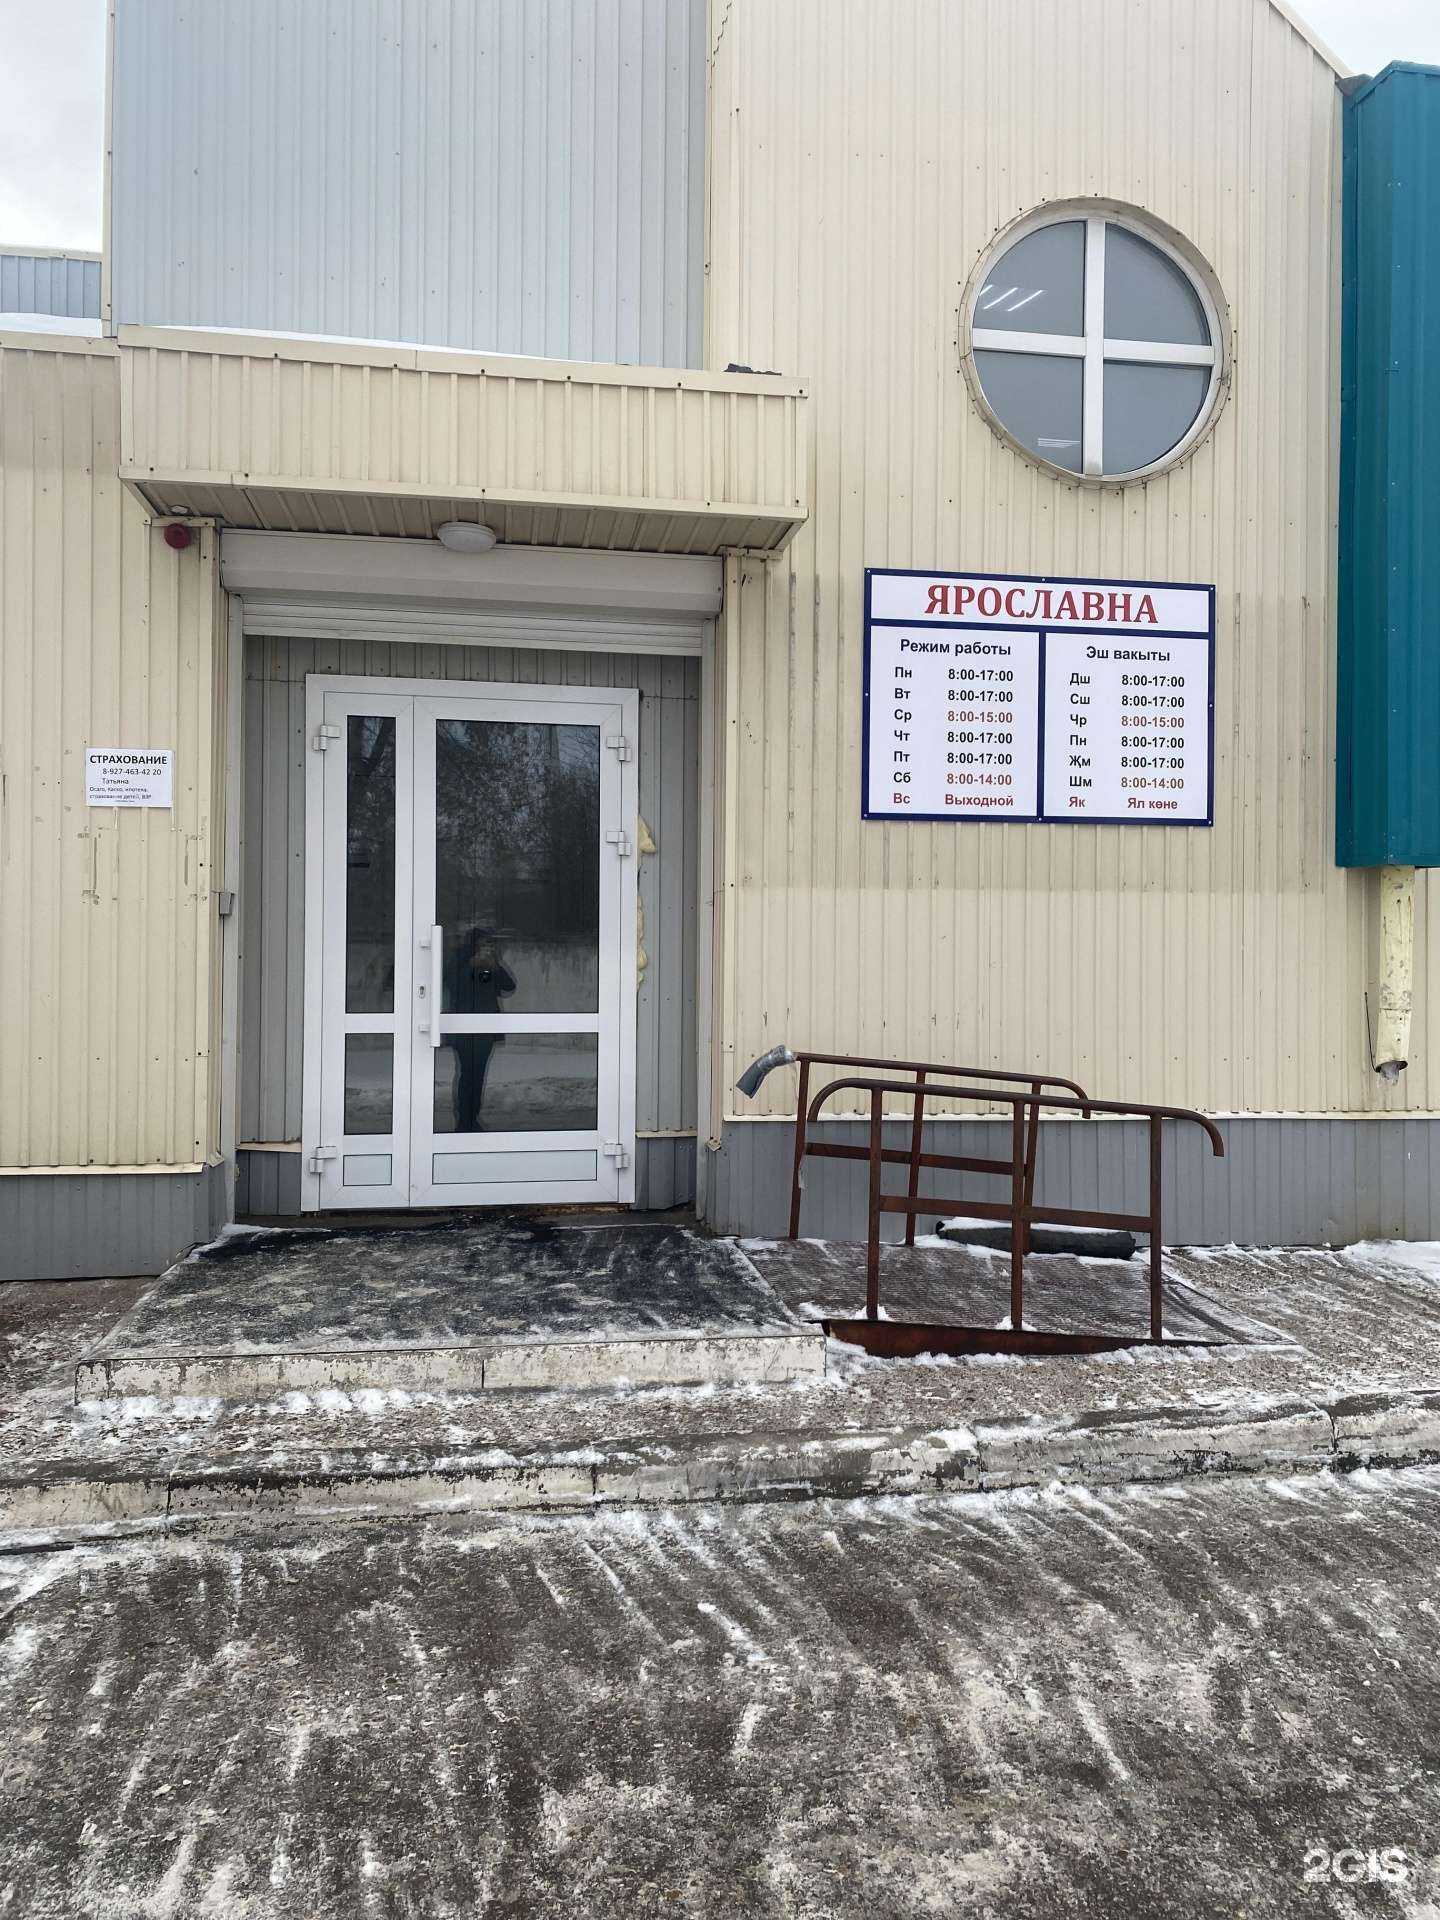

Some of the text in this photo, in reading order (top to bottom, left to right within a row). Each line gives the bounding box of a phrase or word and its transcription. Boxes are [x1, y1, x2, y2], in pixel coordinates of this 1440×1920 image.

[924, 584, 1159, 624] ЯРОСЛАВНА
[900, 639, 1011, 657] Режим работы
[1086, 647, 1170, 662] Эш вакыты
[894, 666, 1014, 682] Пн 8:00-17:00
[1069, 672, 1185, 688] Дш 8:00-17:00
[894, 687, 1014, 703] Вт 8:00-17:00
[1069, 693, 1185, 708] Сш 8:00-17:00
[893, 708, 1013, 724] Ср 8:00-15:00
[1069, 713, 1185, 729] Чр 8:00-15:00
[893, 729, 1013, 745] Чт 8:00-17:00
[1069, 734, 1185, 749] Пн 8:00-17:00
[89, 755, 168, 765] СТРАХОВАНИЕ
[893, 750, 1013, 766] Пт 8:00-17:00
[1068, 754, 1185, 769] Җм 8:00-17:00
[102, 768, 151, 776] 8-927-463-42
[893, 771, 1012, 786] Сб 8:00-14:00
[1069, 775, 1185, 790] Шм 8:00-14:00
[893, 792, 1014, 807] Вс Выходной
[1068, 796, 1178, 810] Як Ял көне
